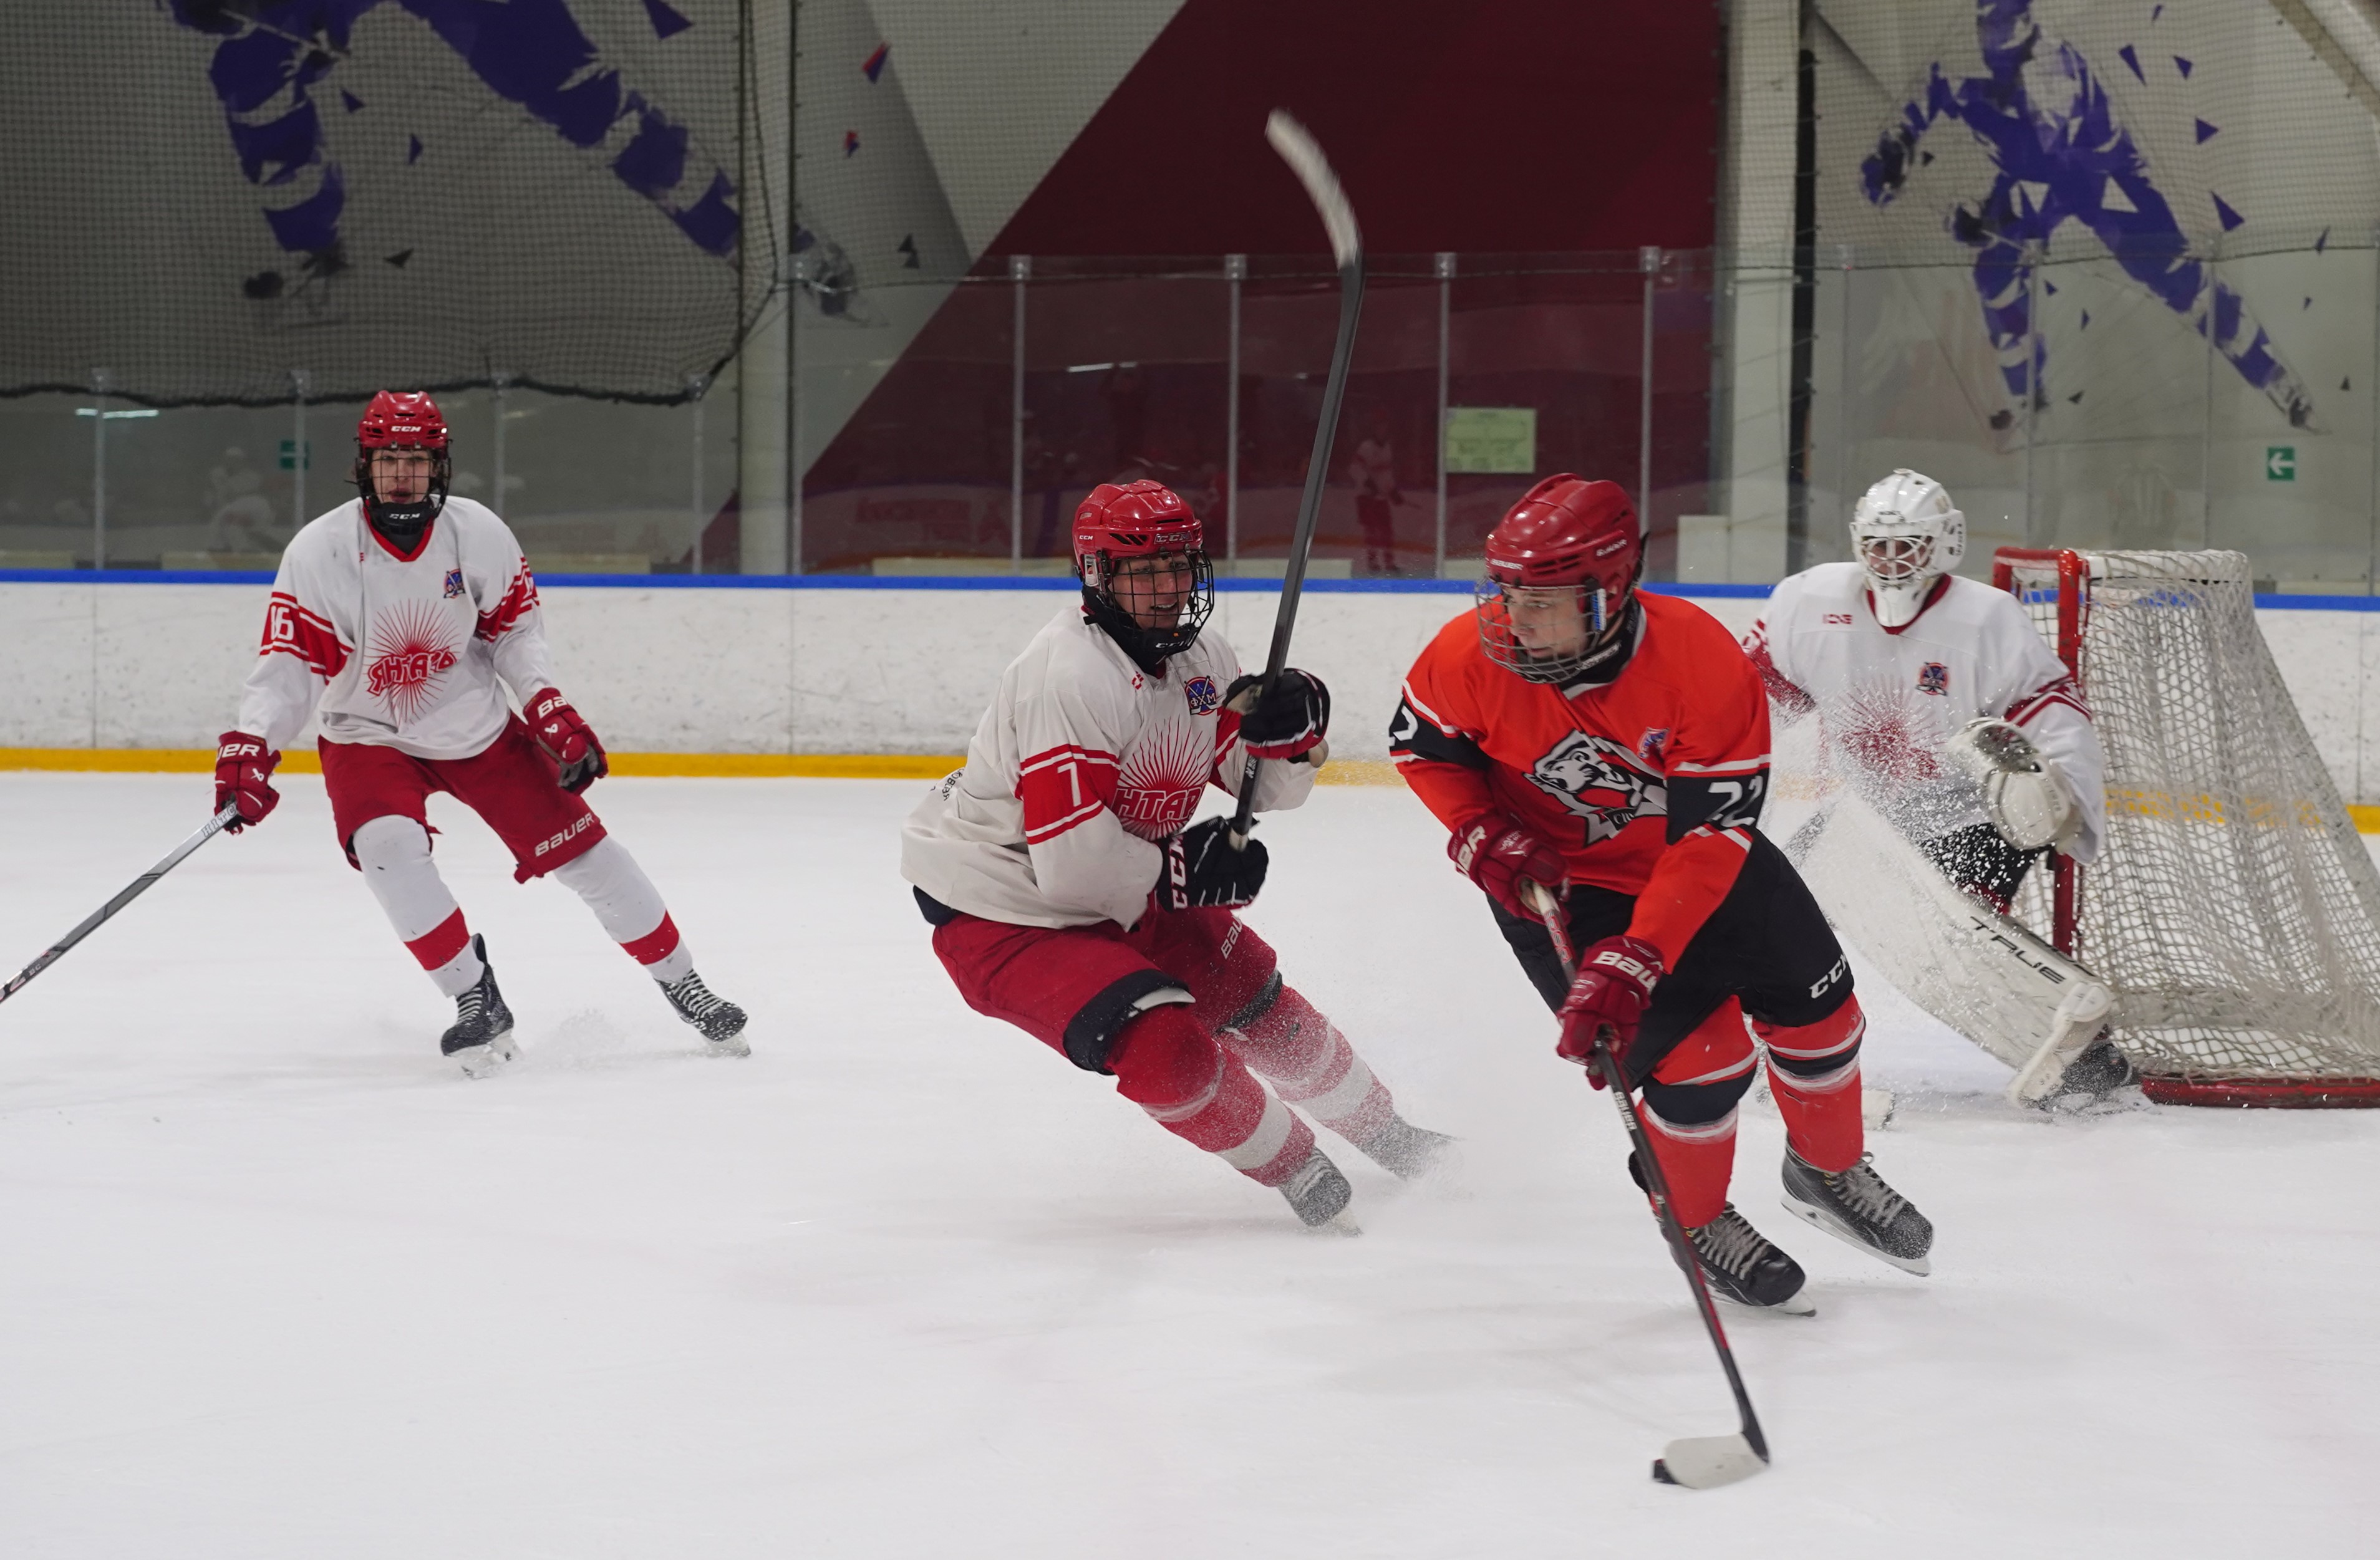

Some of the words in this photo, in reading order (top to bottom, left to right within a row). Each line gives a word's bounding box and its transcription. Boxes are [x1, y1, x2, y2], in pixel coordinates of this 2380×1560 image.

[1156, 532, 1190, 542] CCM
[271, 605, 294, 641] 16
[1057, 761, 1082, 807] 7
[535, 812, 595, 857] BAUER
[1970, 916, 2066, 985] TRUE
